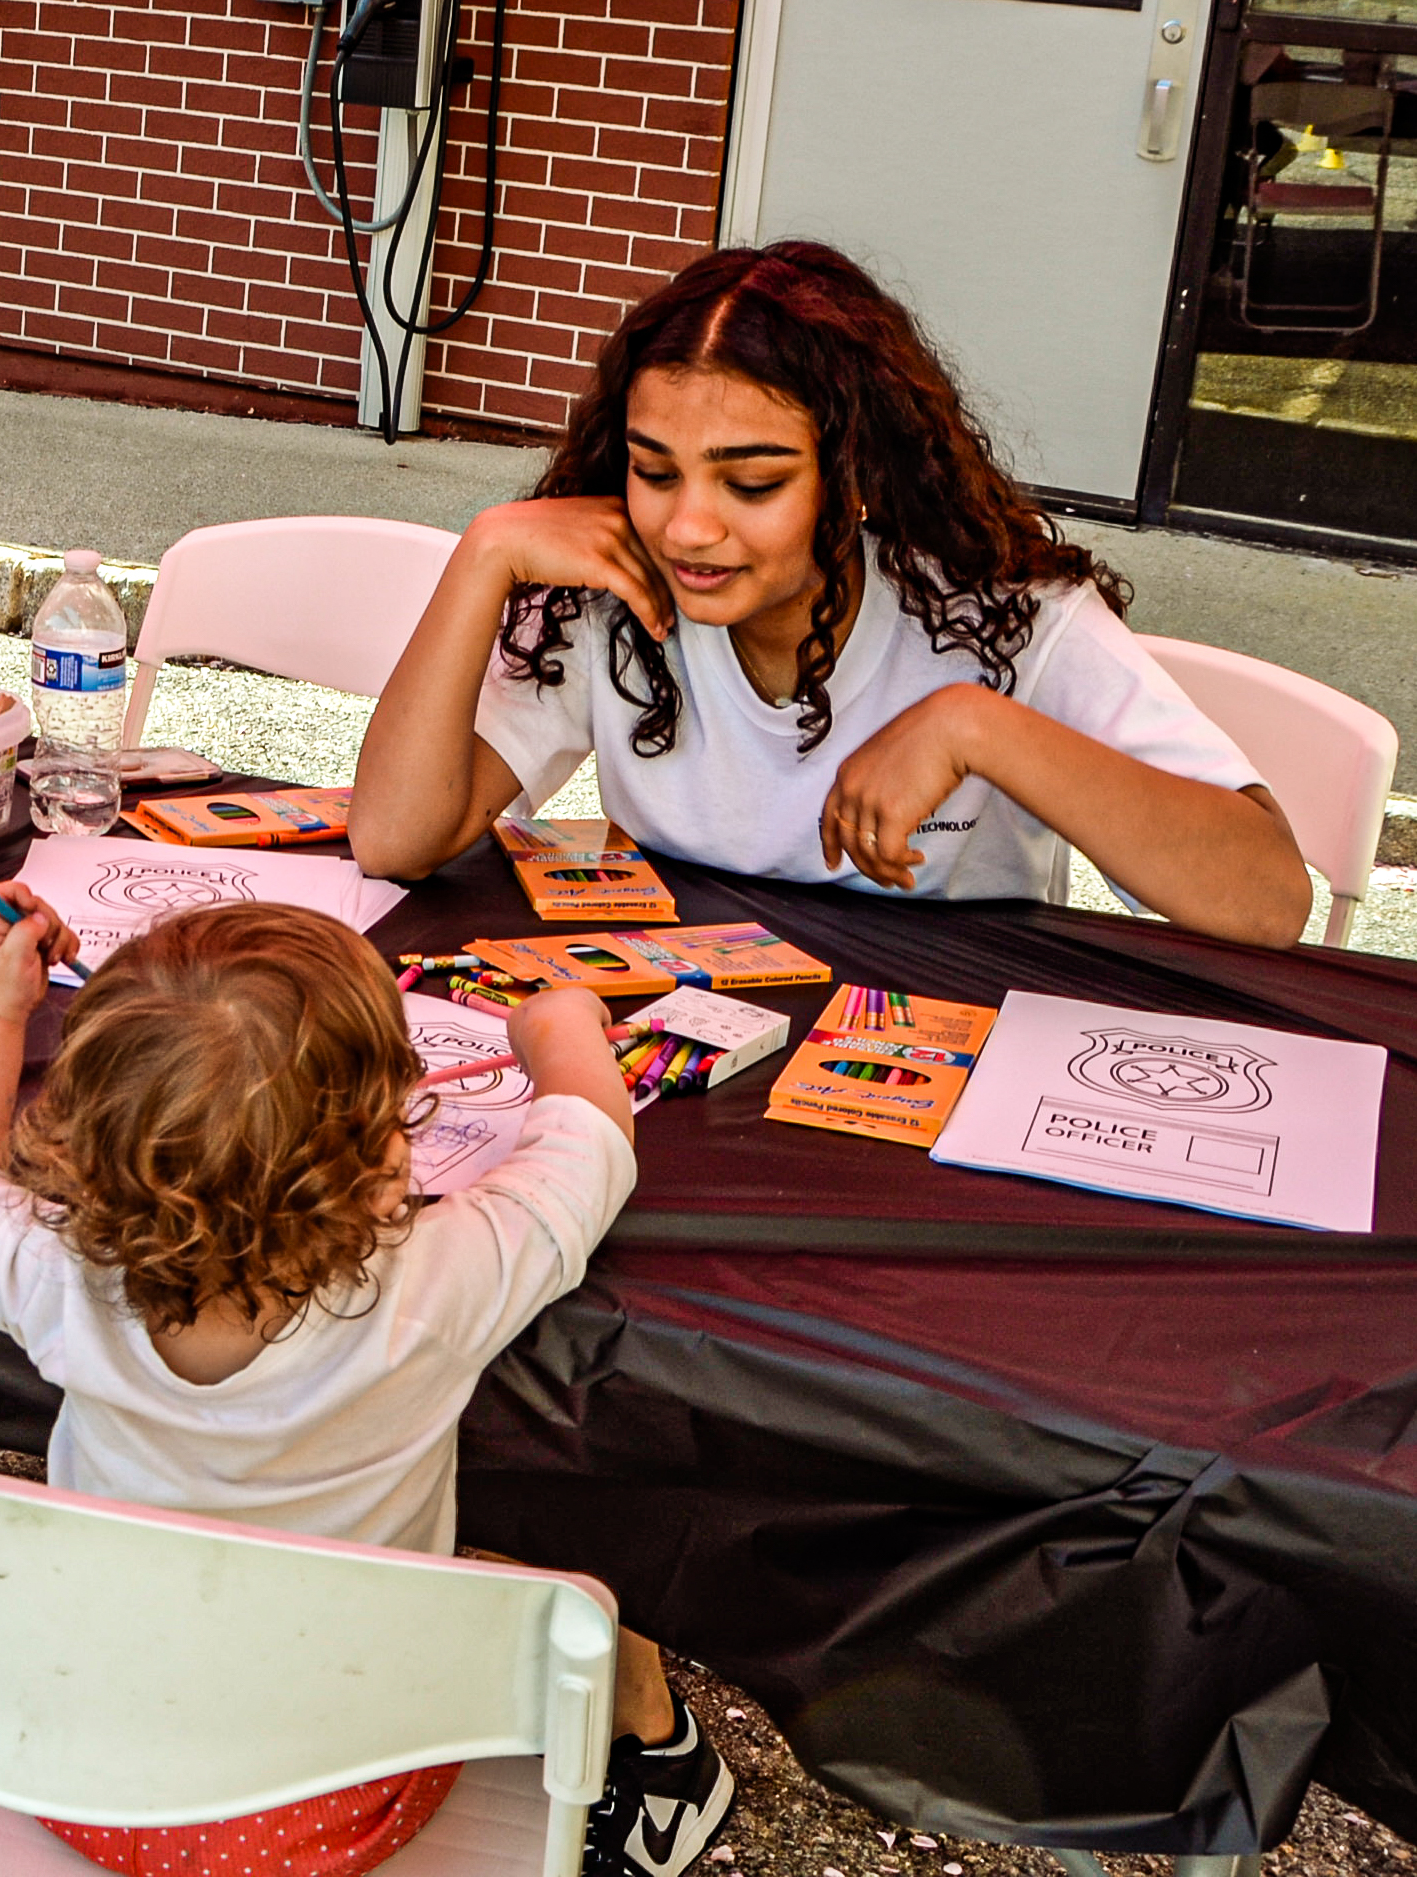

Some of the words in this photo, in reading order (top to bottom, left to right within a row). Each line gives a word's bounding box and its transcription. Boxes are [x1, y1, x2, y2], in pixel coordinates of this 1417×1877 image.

[916, 817, 979, 834] TECHNOLOG
[140, 867, 211, 878] POLICE
[79, 928, 133, 940] POLI
[730, 977, 763, 985] Erasable
[764, 975, 794, 983] Colored
[795, 974, 821, 982] Pencils
[443, 1036, 509, 1057] POLIC
[1132, 1043, 1219, 1063] POLICE
[790, 1098, 824, 1111] Pencils
[826, 1104, 863, 1118] Colored
[866, 1111, 907, 1125] Erasable
[1050, 1113, 1158, 1142] POLICE
[1044, 1127, 1153, 1154] OFFICER
